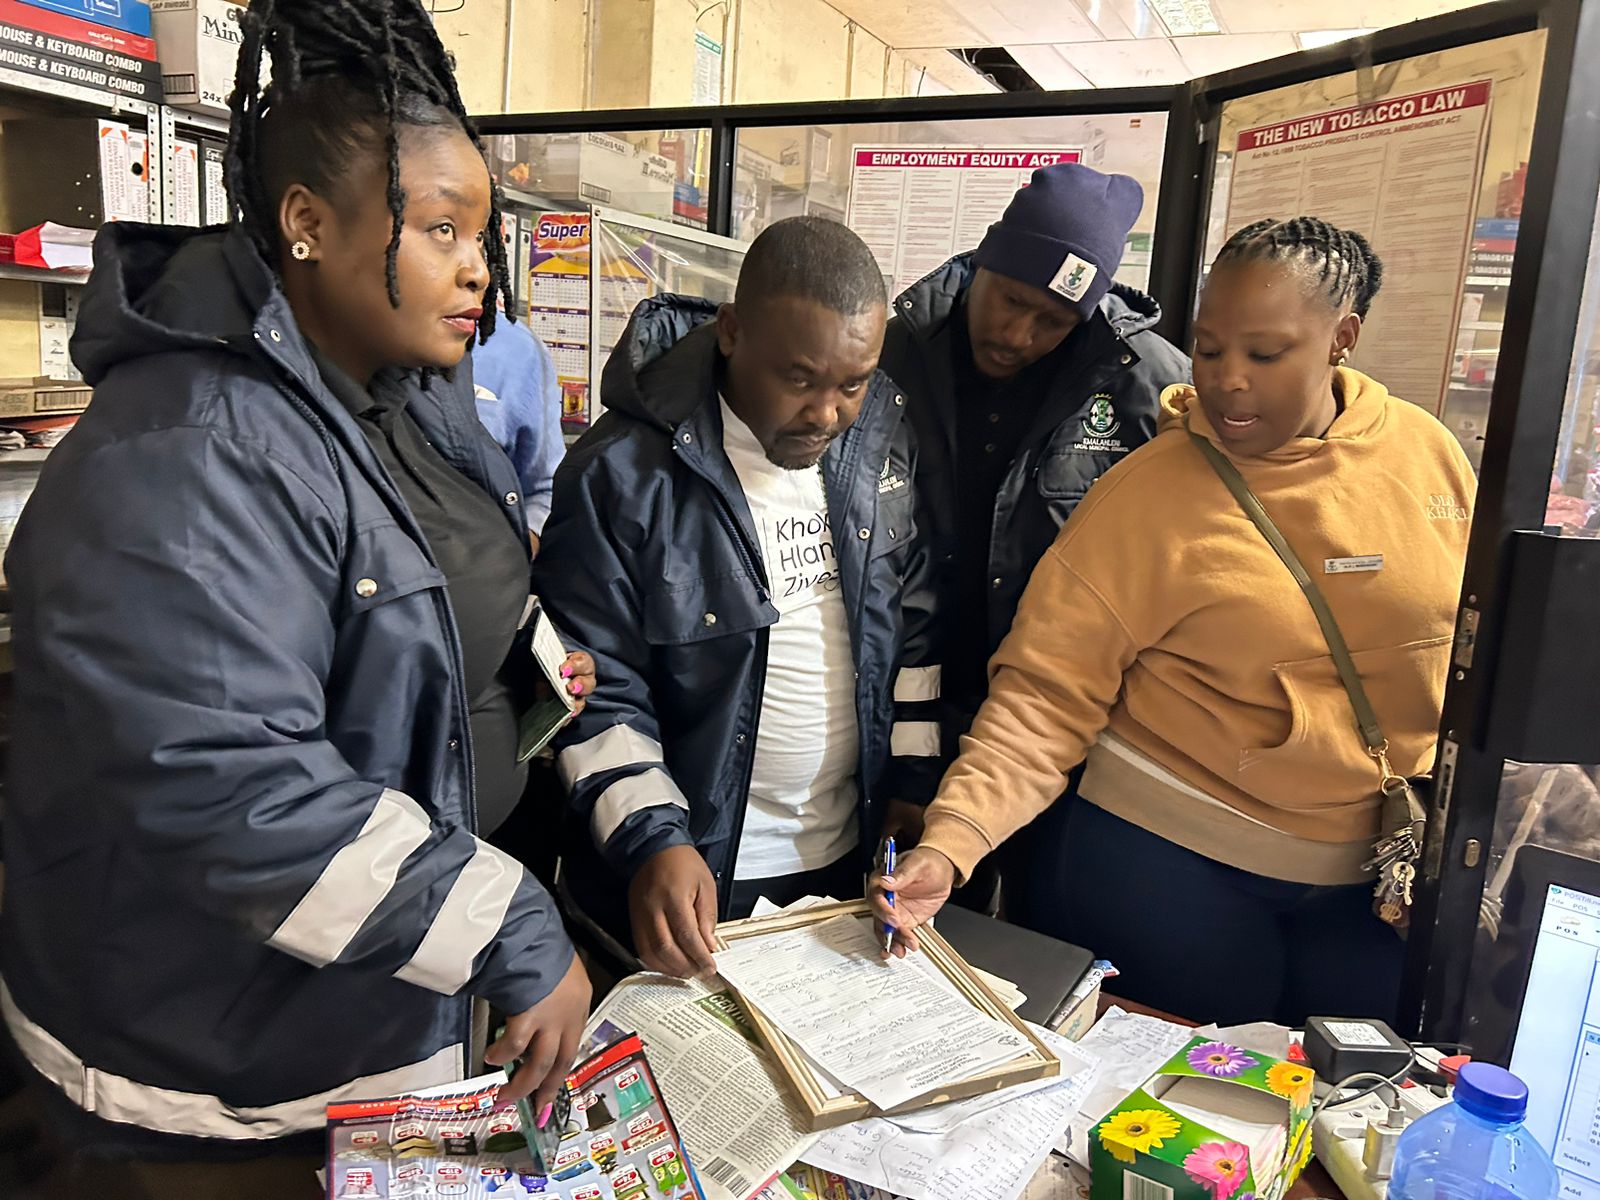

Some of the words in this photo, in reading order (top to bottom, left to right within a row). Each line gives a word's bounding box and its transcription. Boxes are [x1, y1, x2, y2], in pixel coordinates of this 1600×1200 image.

[35, 36, 45, 49] &
[47, 38, 104, 64] KEYBOARD
[105, 54, 143, 74] COMBO
[38, 58, 48, 72] &
[50, 61, 107, 86] KEYBOARD
[108, 76, 145, 95] COMBO
[1253, 131, 1283, 147] THE
[1288, 117, 1325, 140] NEW
[1329, 100, 1416, 132] TOBACCO
[1420, 90, 1467, 115] LAW
[872, 153, 967, 166] EMPLOYMENT
[971, 153, 1025, 167] EQUITY
[1028, 154, 1061, 167] ACT
[538, 222, 587, 241] Super
[1429, 495, 1455, 507] OLD
[1563, 1152, 1591, 1167] Select
[1563, 1185, 1582, 1197] Add
